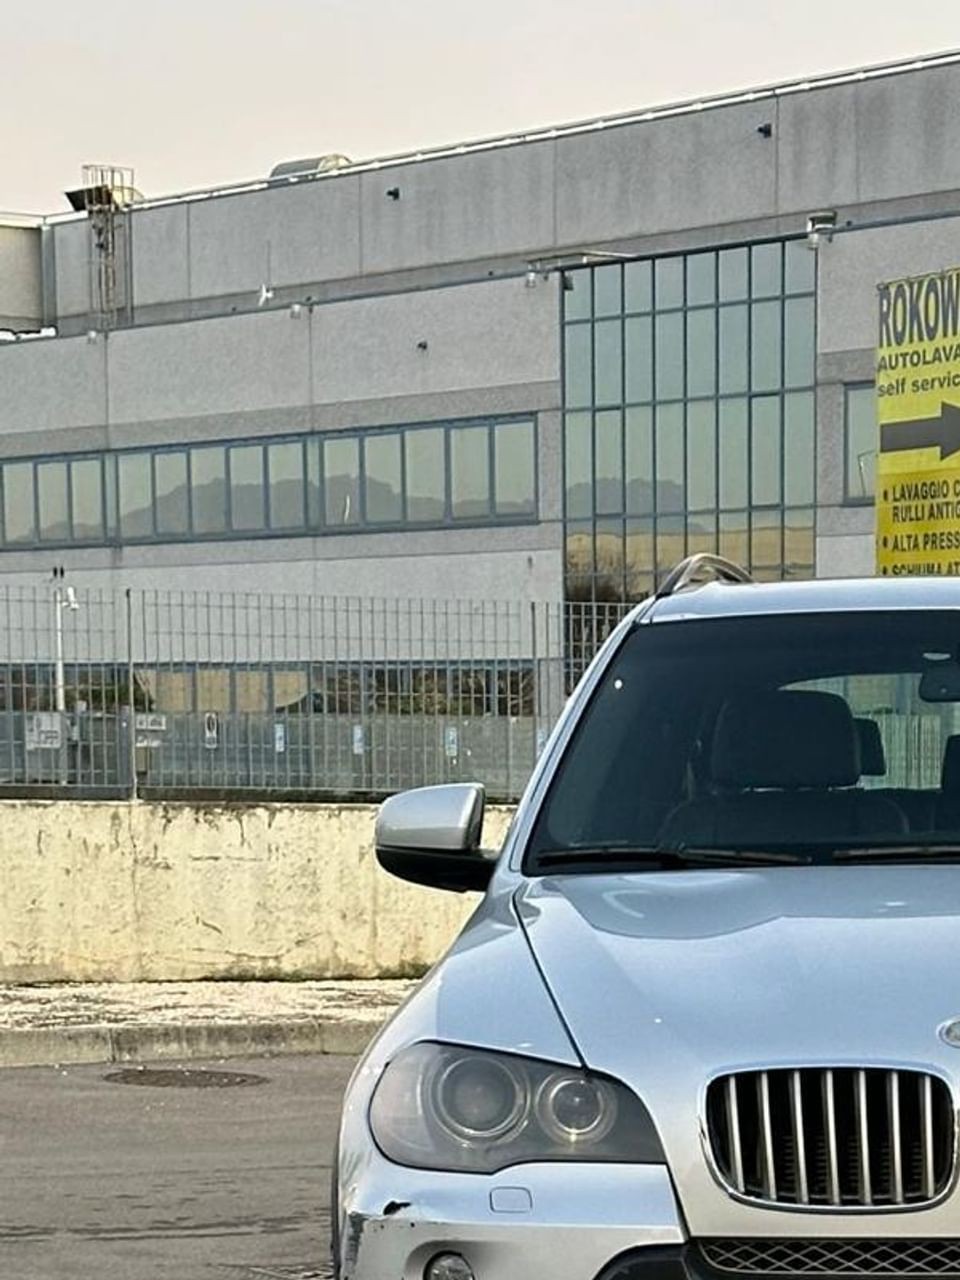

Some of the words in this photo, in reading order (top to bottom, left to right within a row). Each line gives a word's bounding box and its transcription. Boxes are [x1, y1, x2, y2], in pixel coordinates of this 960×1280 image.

[877, 378, 907, 398] self
[891, 479, 950, 502] LAVAGGIO
[891, 501, 925, 524] RULLI
[891, 533, 920, 553] ALTA
